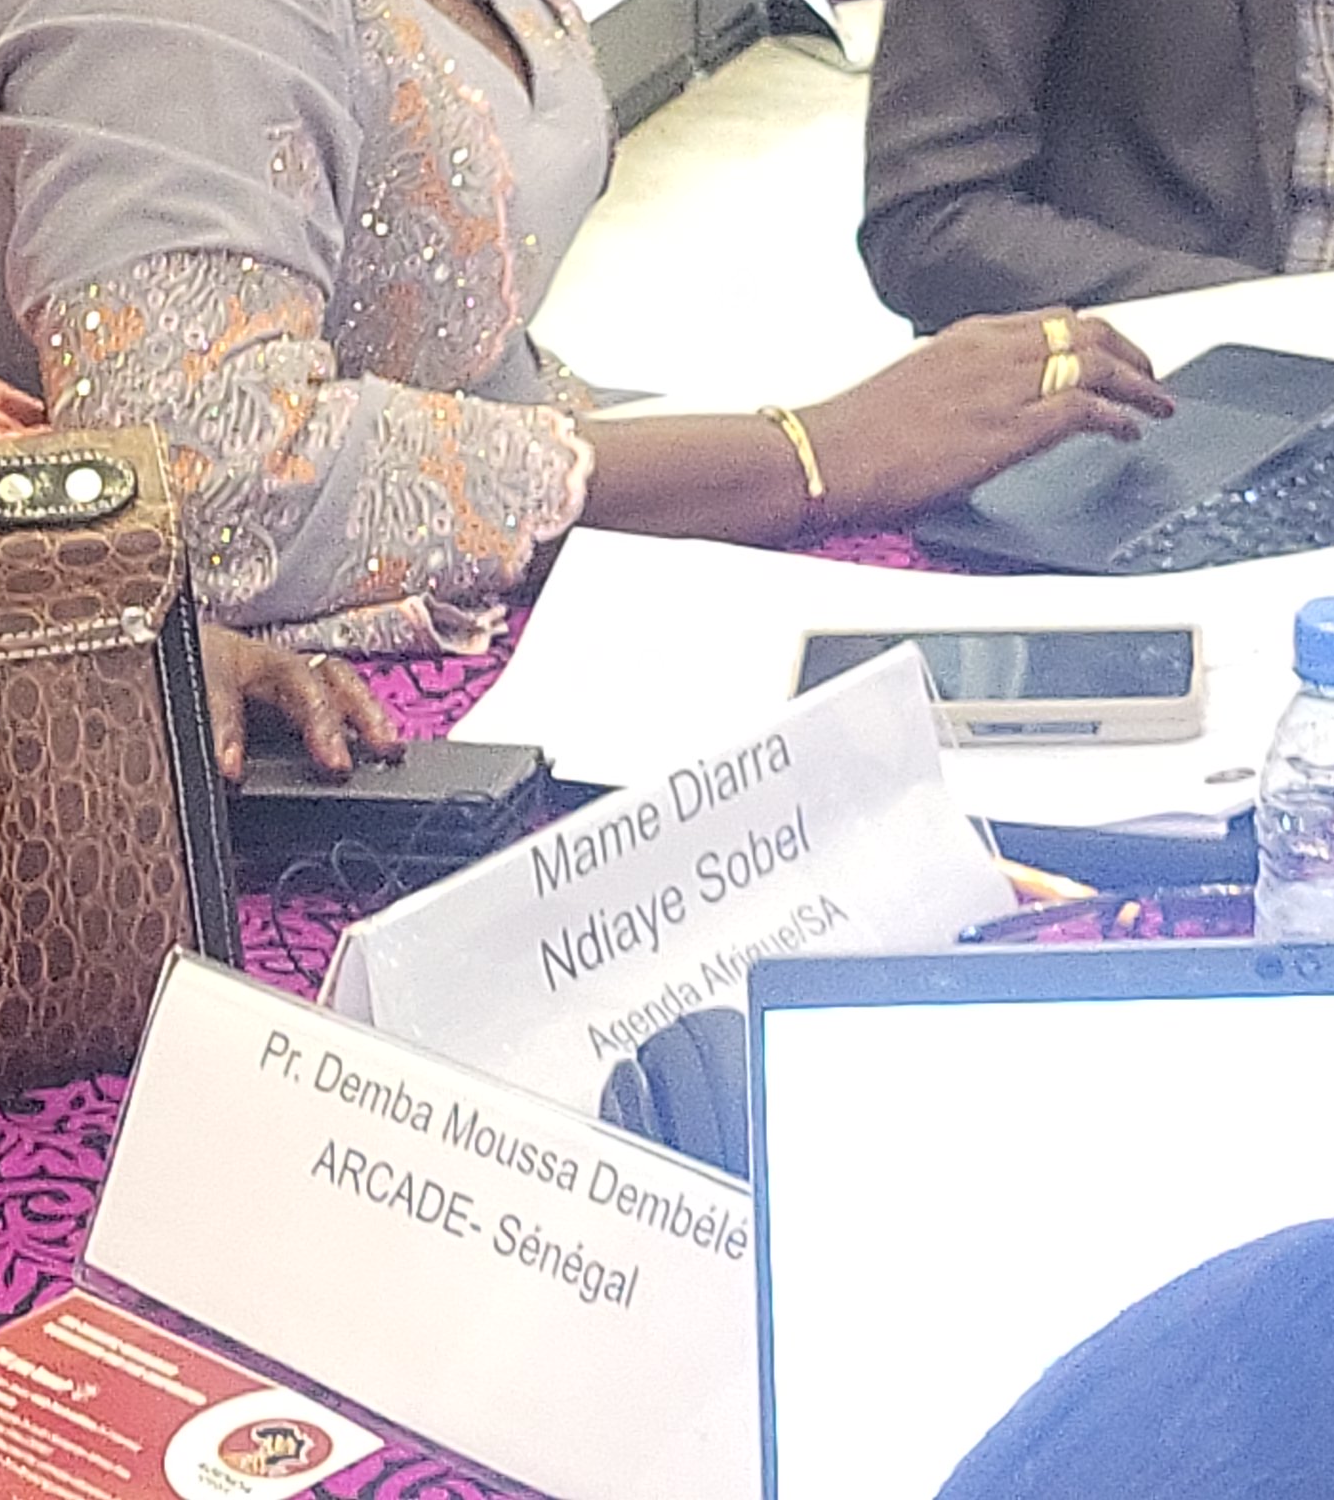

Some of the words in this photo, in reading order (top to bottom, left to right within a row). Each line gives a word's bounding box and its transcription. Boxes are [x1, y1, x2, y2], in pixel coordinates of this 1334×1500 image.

[529, 803, 661, 899] Mame
[668, 731, 792, 818] Diarra
[537, 886, 687, 993] Ndiaye
[695, 808, 812, 906] Sobel
[259, 1028, 304, 1084] Pr.
[314, 1050, 434, 1134] Demba
[441, 1104, 580, 1194] Moussa
[587, 1160, 749, 1262] Dembélé
[310, 1137, 484, 1238] ARCADE-
[491, 1210, 641, 1310] Sénégal
